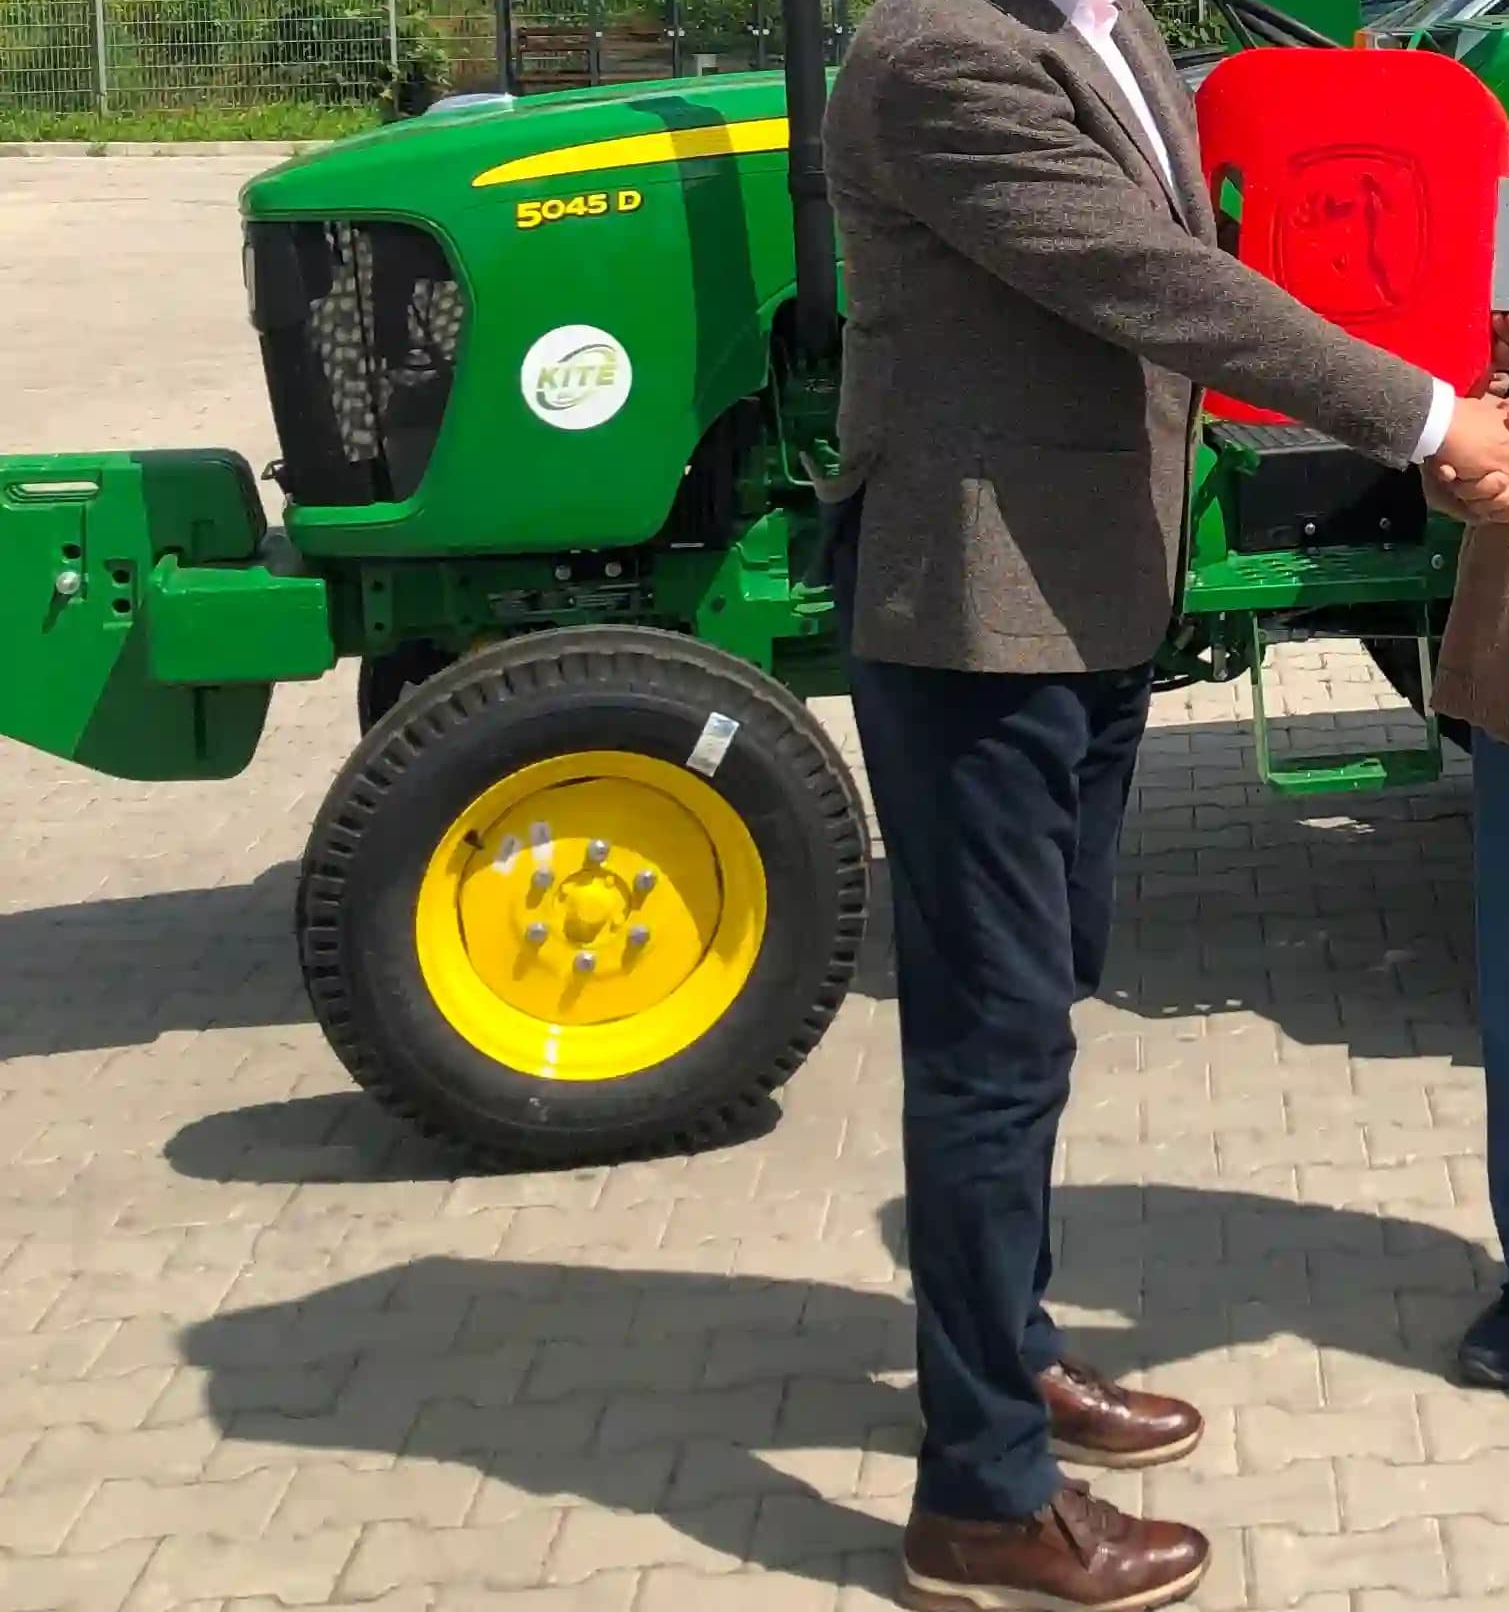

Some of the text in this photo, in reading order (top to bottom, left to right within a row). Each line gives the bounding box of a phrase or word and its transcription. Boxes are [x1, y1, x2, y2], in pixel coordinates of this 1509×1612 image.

[516, 189, 642, 228] 5045 D
[537, 364, 615, 389] KITE
